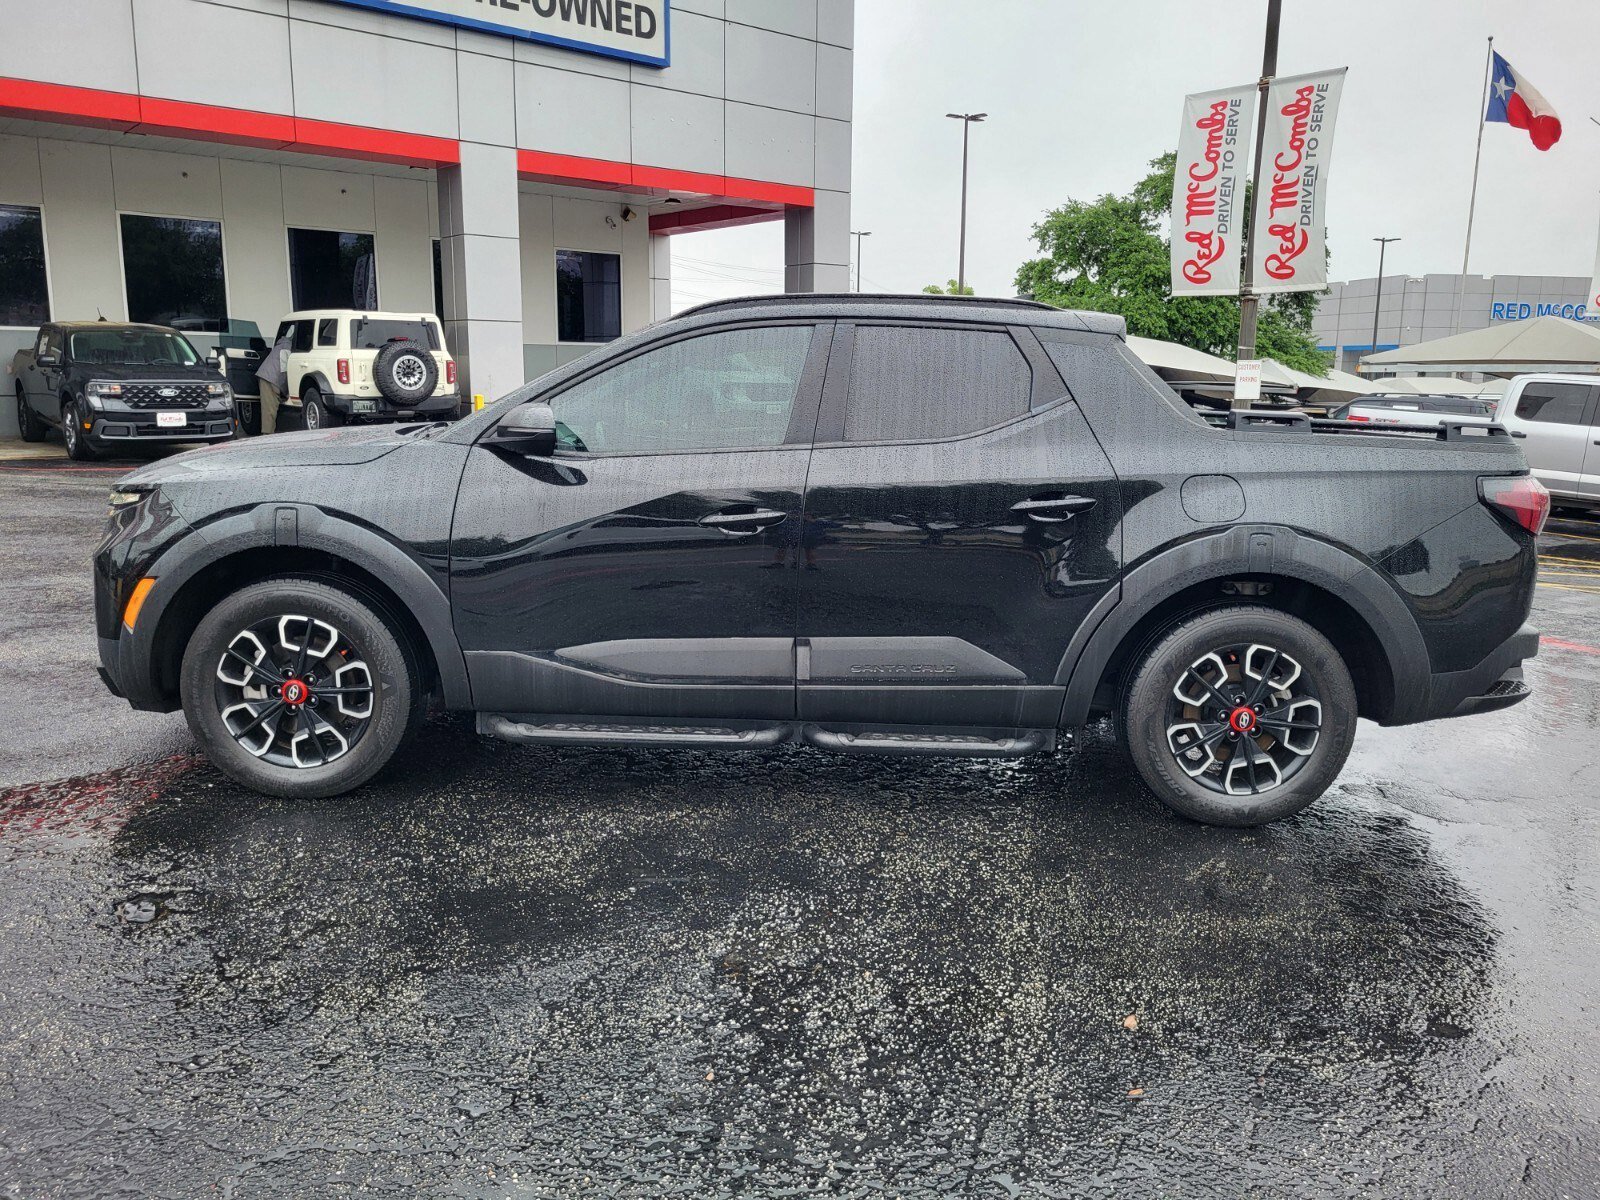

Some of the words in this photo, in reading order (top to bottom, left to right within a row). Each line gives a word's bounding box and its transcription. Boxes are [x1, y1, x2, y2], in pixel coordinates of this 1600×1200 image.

[476, 0, 656, 40] -OWNED
[1225, 98, 1242, 146] SERVE
[1309, 83, 1329, 133] SERVE
[1185, 100, 1228, 226] McCombs
[1222, 150, 1235, 172] TO
[1268, 85, 1315, 220] McCombs
[1305, 137, 1319, 160] TO
[1217, 176, 1233, 235] DRIVEN
[1300, 165, 1315, 227] DRIVEN
[1182, 230, 1225, 285] Red
[1264, 221, 1309, 280] Red
[1492, 302, 1531, 320] RED
[850, 664, 907, 673] SANTA
[910, 664, 957, 673] CRUZ
